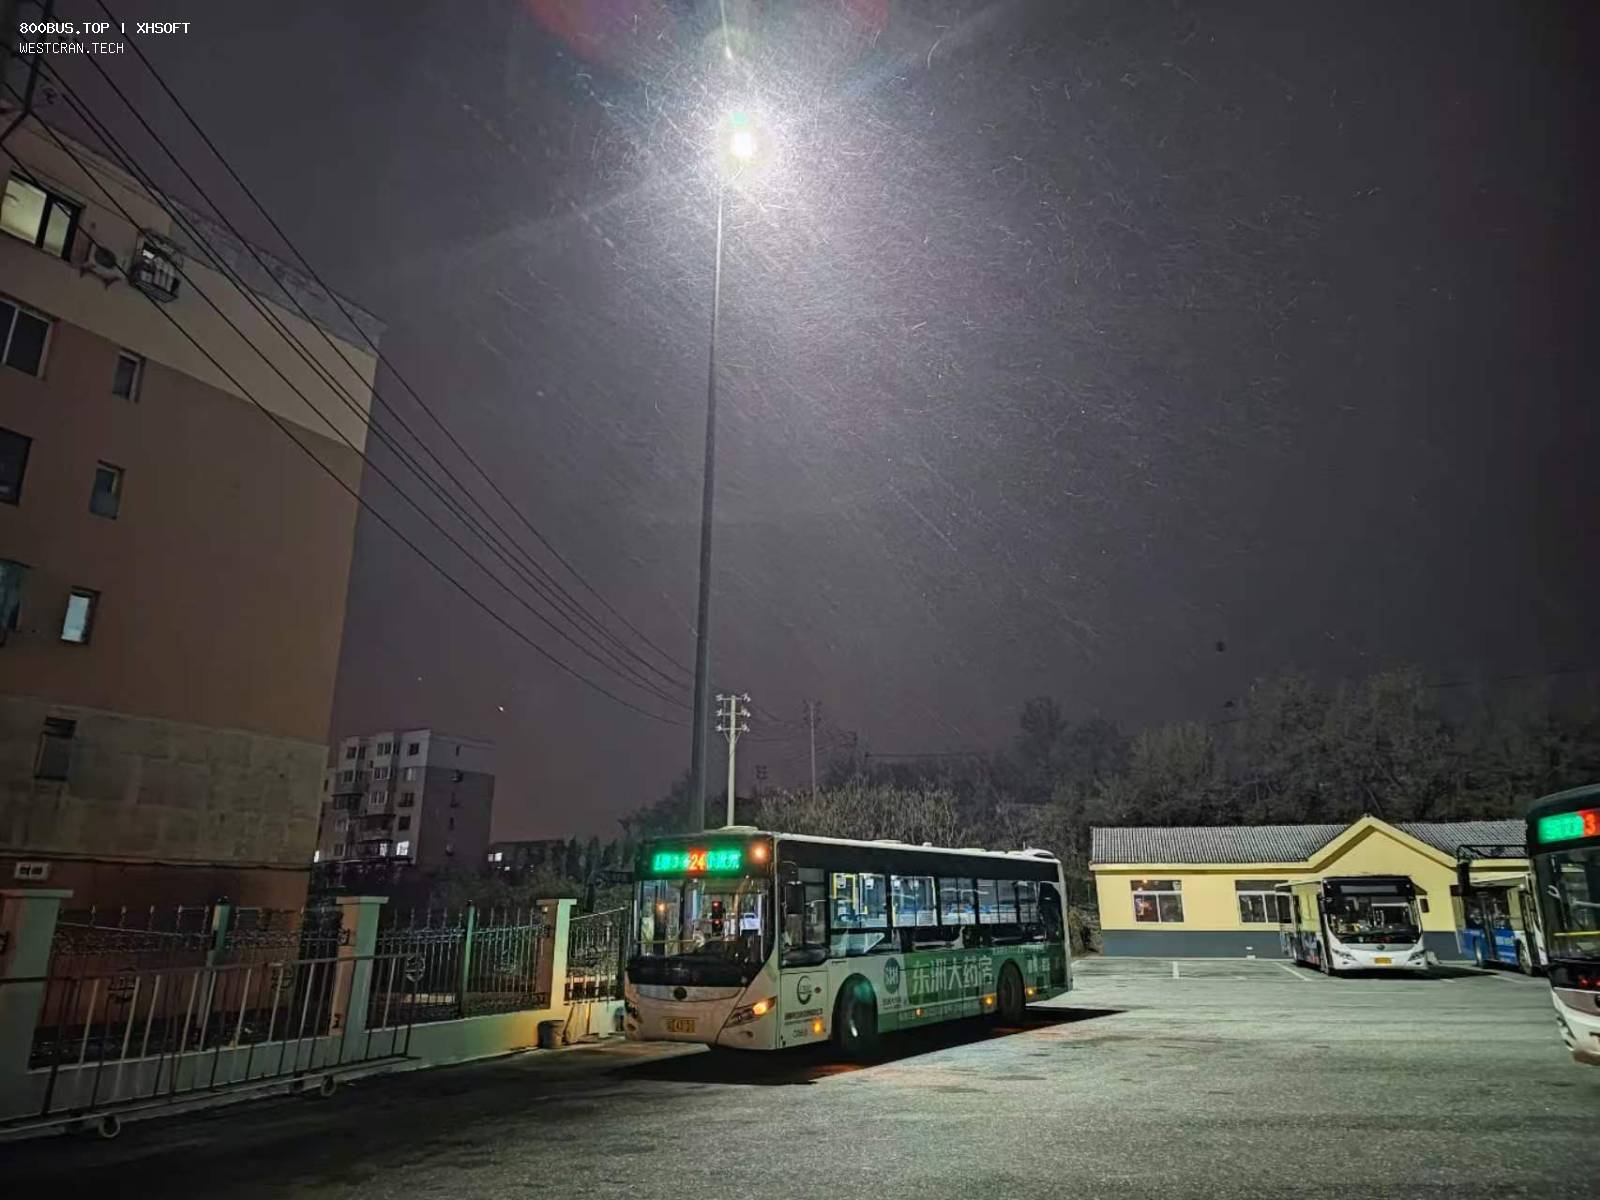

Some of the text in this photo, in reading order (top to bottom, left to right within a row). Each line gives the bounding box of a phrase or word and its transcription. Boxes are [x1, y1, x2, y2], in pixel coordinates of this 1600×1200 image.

[689, 854, 706, 870] 24
[911, 955, 993, 995] 东洲大药房
